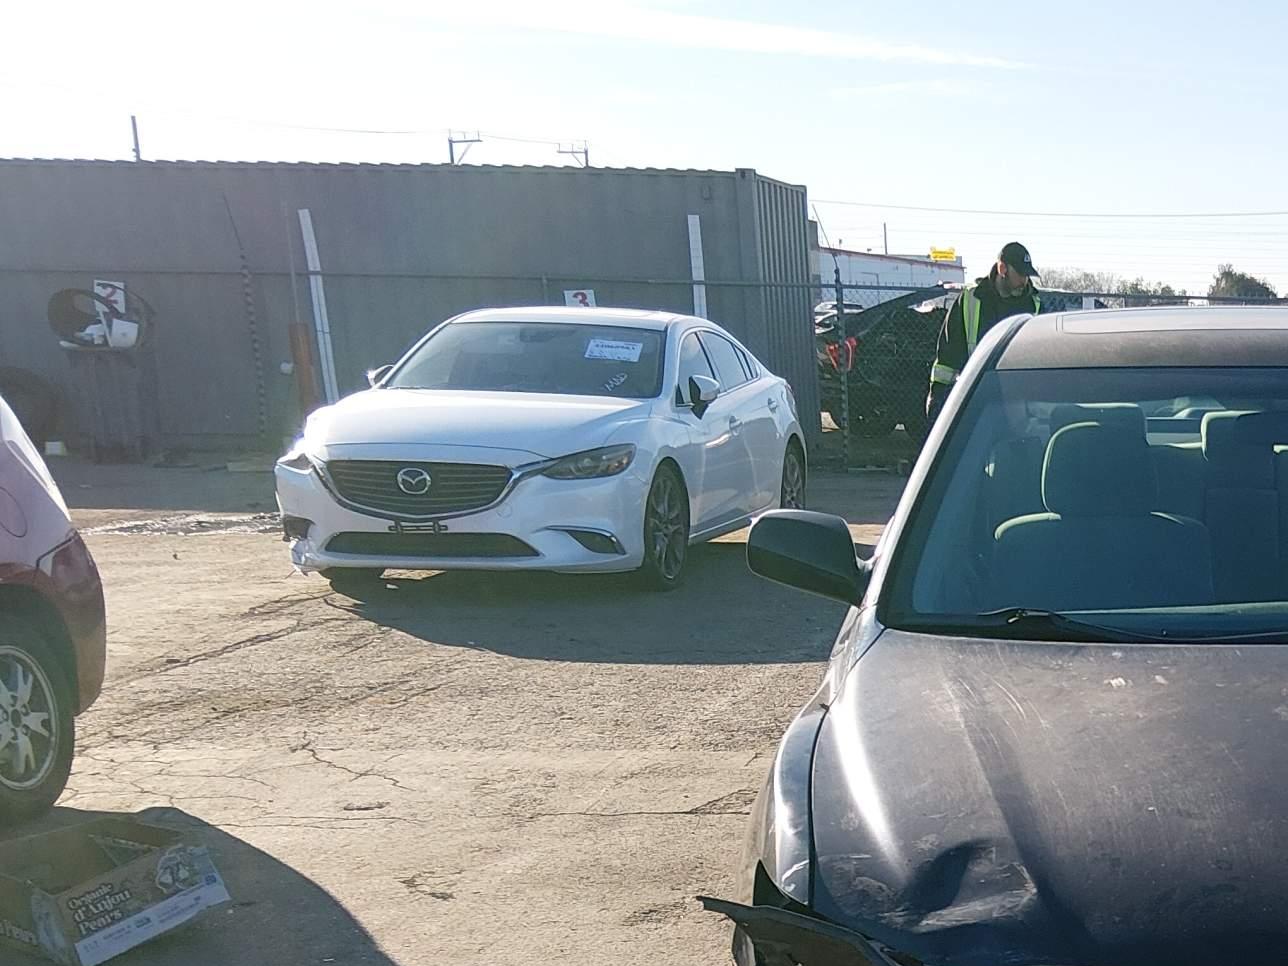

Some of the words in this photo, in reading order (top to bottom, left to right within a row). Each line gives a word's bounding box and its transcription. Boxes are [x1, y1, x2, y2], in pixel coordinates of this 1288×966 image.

[573, 291, 589, 307] 3
[68, 883, 113, 910] Organic
[79, 910, 122, 935] Pears
